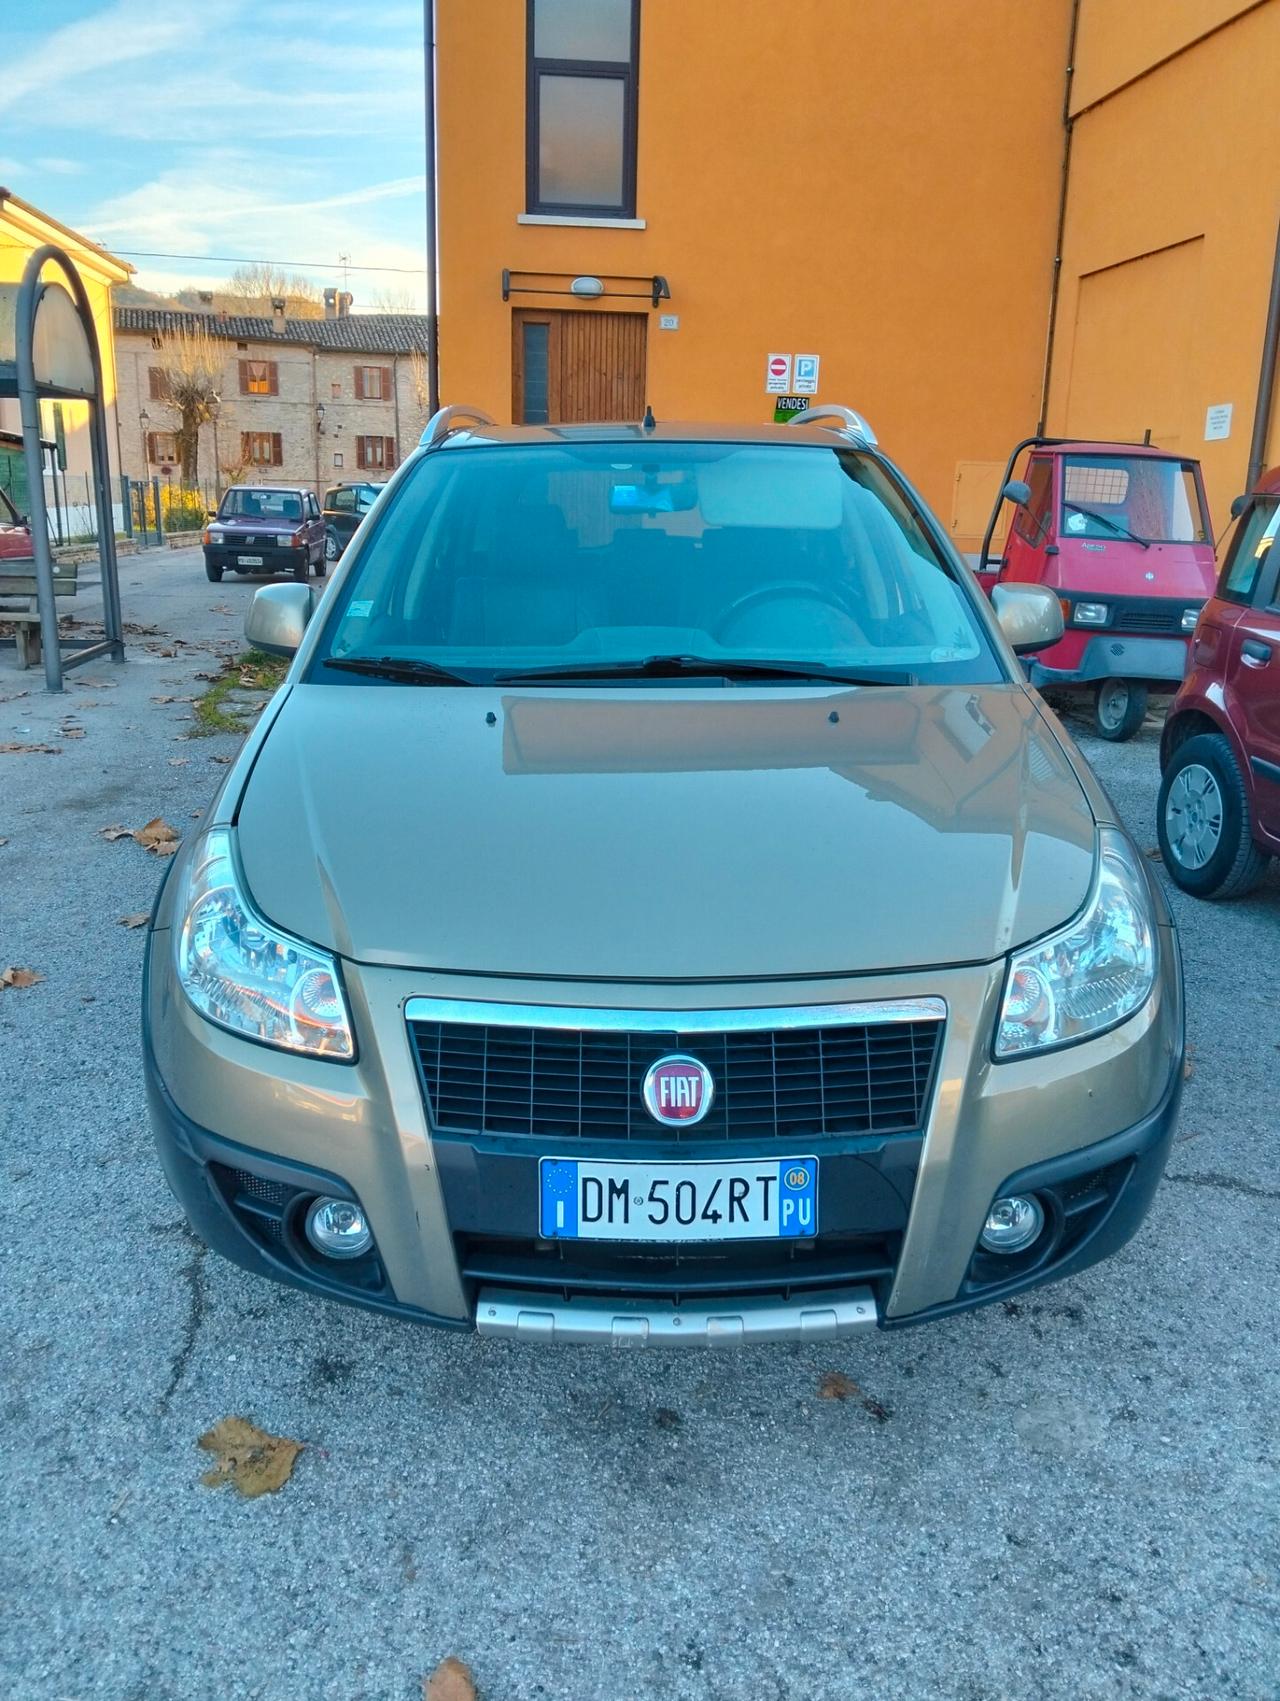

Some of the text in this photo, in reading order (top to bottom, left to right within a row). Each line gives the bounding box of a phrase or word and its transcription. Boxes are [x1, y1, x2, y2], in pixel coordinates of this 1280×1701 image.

[663, 318, 674, 327] 20
[800, 360, 813, 376] P
[660, 1076, 700, 1108] FIAT
[789, 1170, 805, 1186] 08
[556, 1200, 564, 1228] I
[783, 1198, 811, 1227] PU
